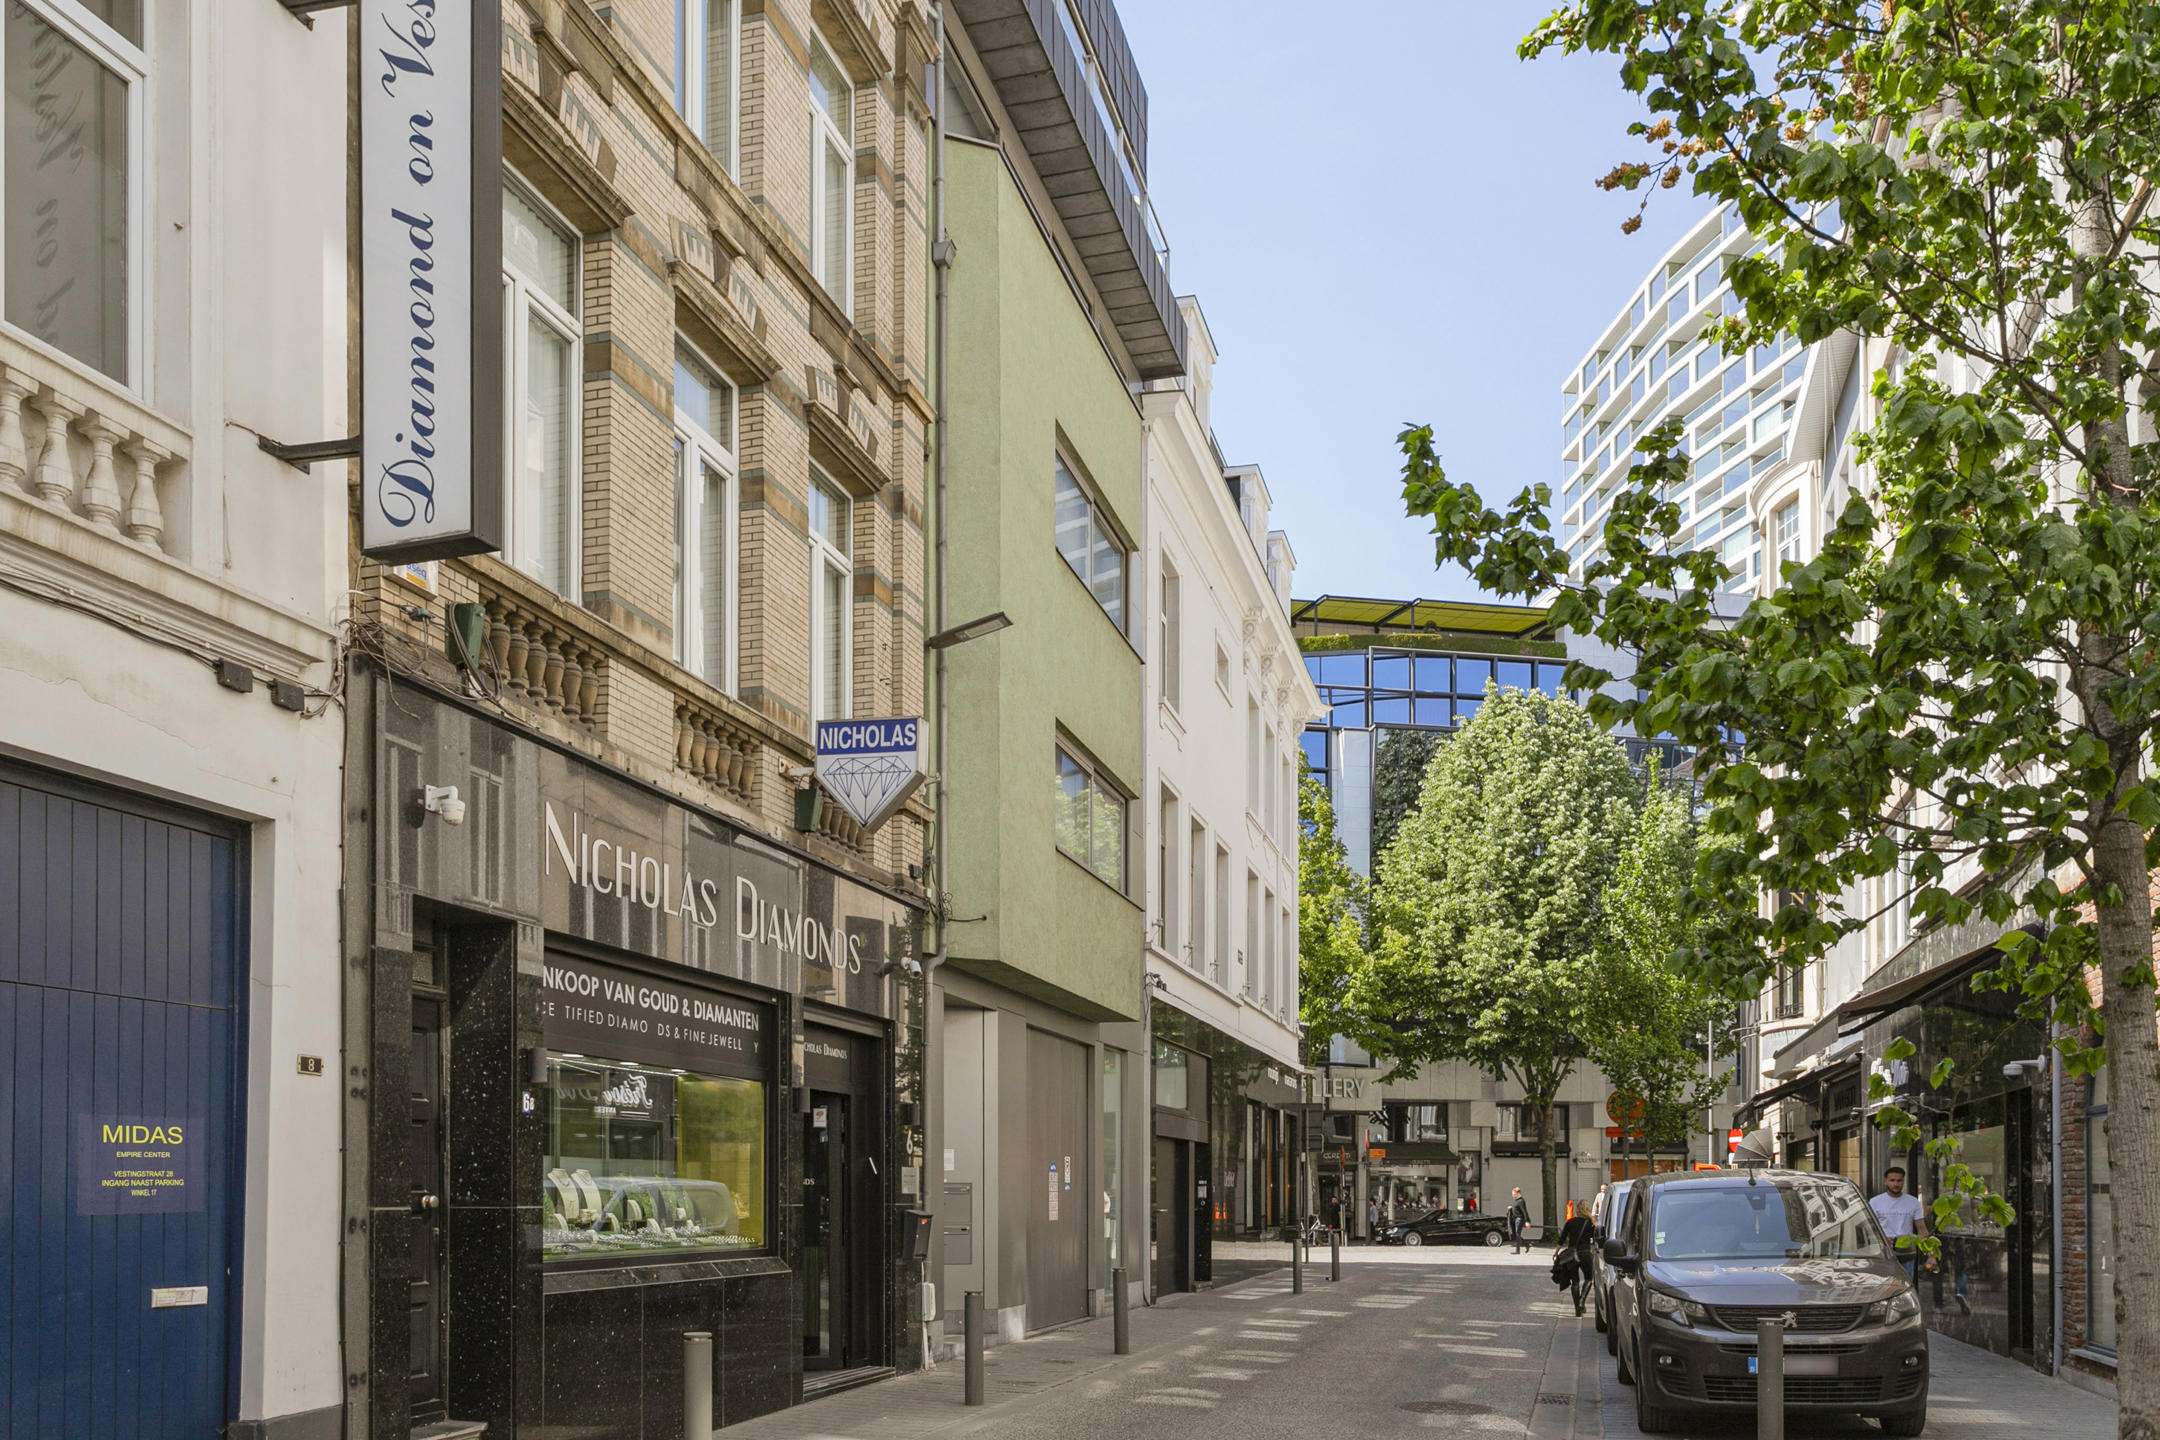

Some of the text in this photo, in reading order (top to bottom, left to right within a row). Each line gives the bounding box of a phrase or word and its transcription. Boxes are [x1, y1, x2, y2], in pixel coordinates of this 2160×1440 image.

[406, 109, 435, 188] on
[378, 207, 436, 528] Diamond
[820, 722, 917, 750] NICHOLAS
[545, 800, 862, 975] NICHOLAS DIAMONDS
[603, 979, 635, 1005] VAN
[638, 987, 679, 1014] GOUD
[682, 1000, 691, 1017] &
[694, 1000, 760, 1032] DIAMANTEN
[673, 1026, 681, 1039] &
[683, 1028, 706, 1044] FINE
[308, 1058, 315, 1071] 8
[102, 1124, 184, 1145] MIDAS
[906, 1129, 913, 1154] 6
[101, 1178, 185, 1187] INGANG NAAST PARKING
[113, 1170, 165, 1178] VESTINGSTRAAT
[130, 1188, 157, 1197] WINKEL 17
